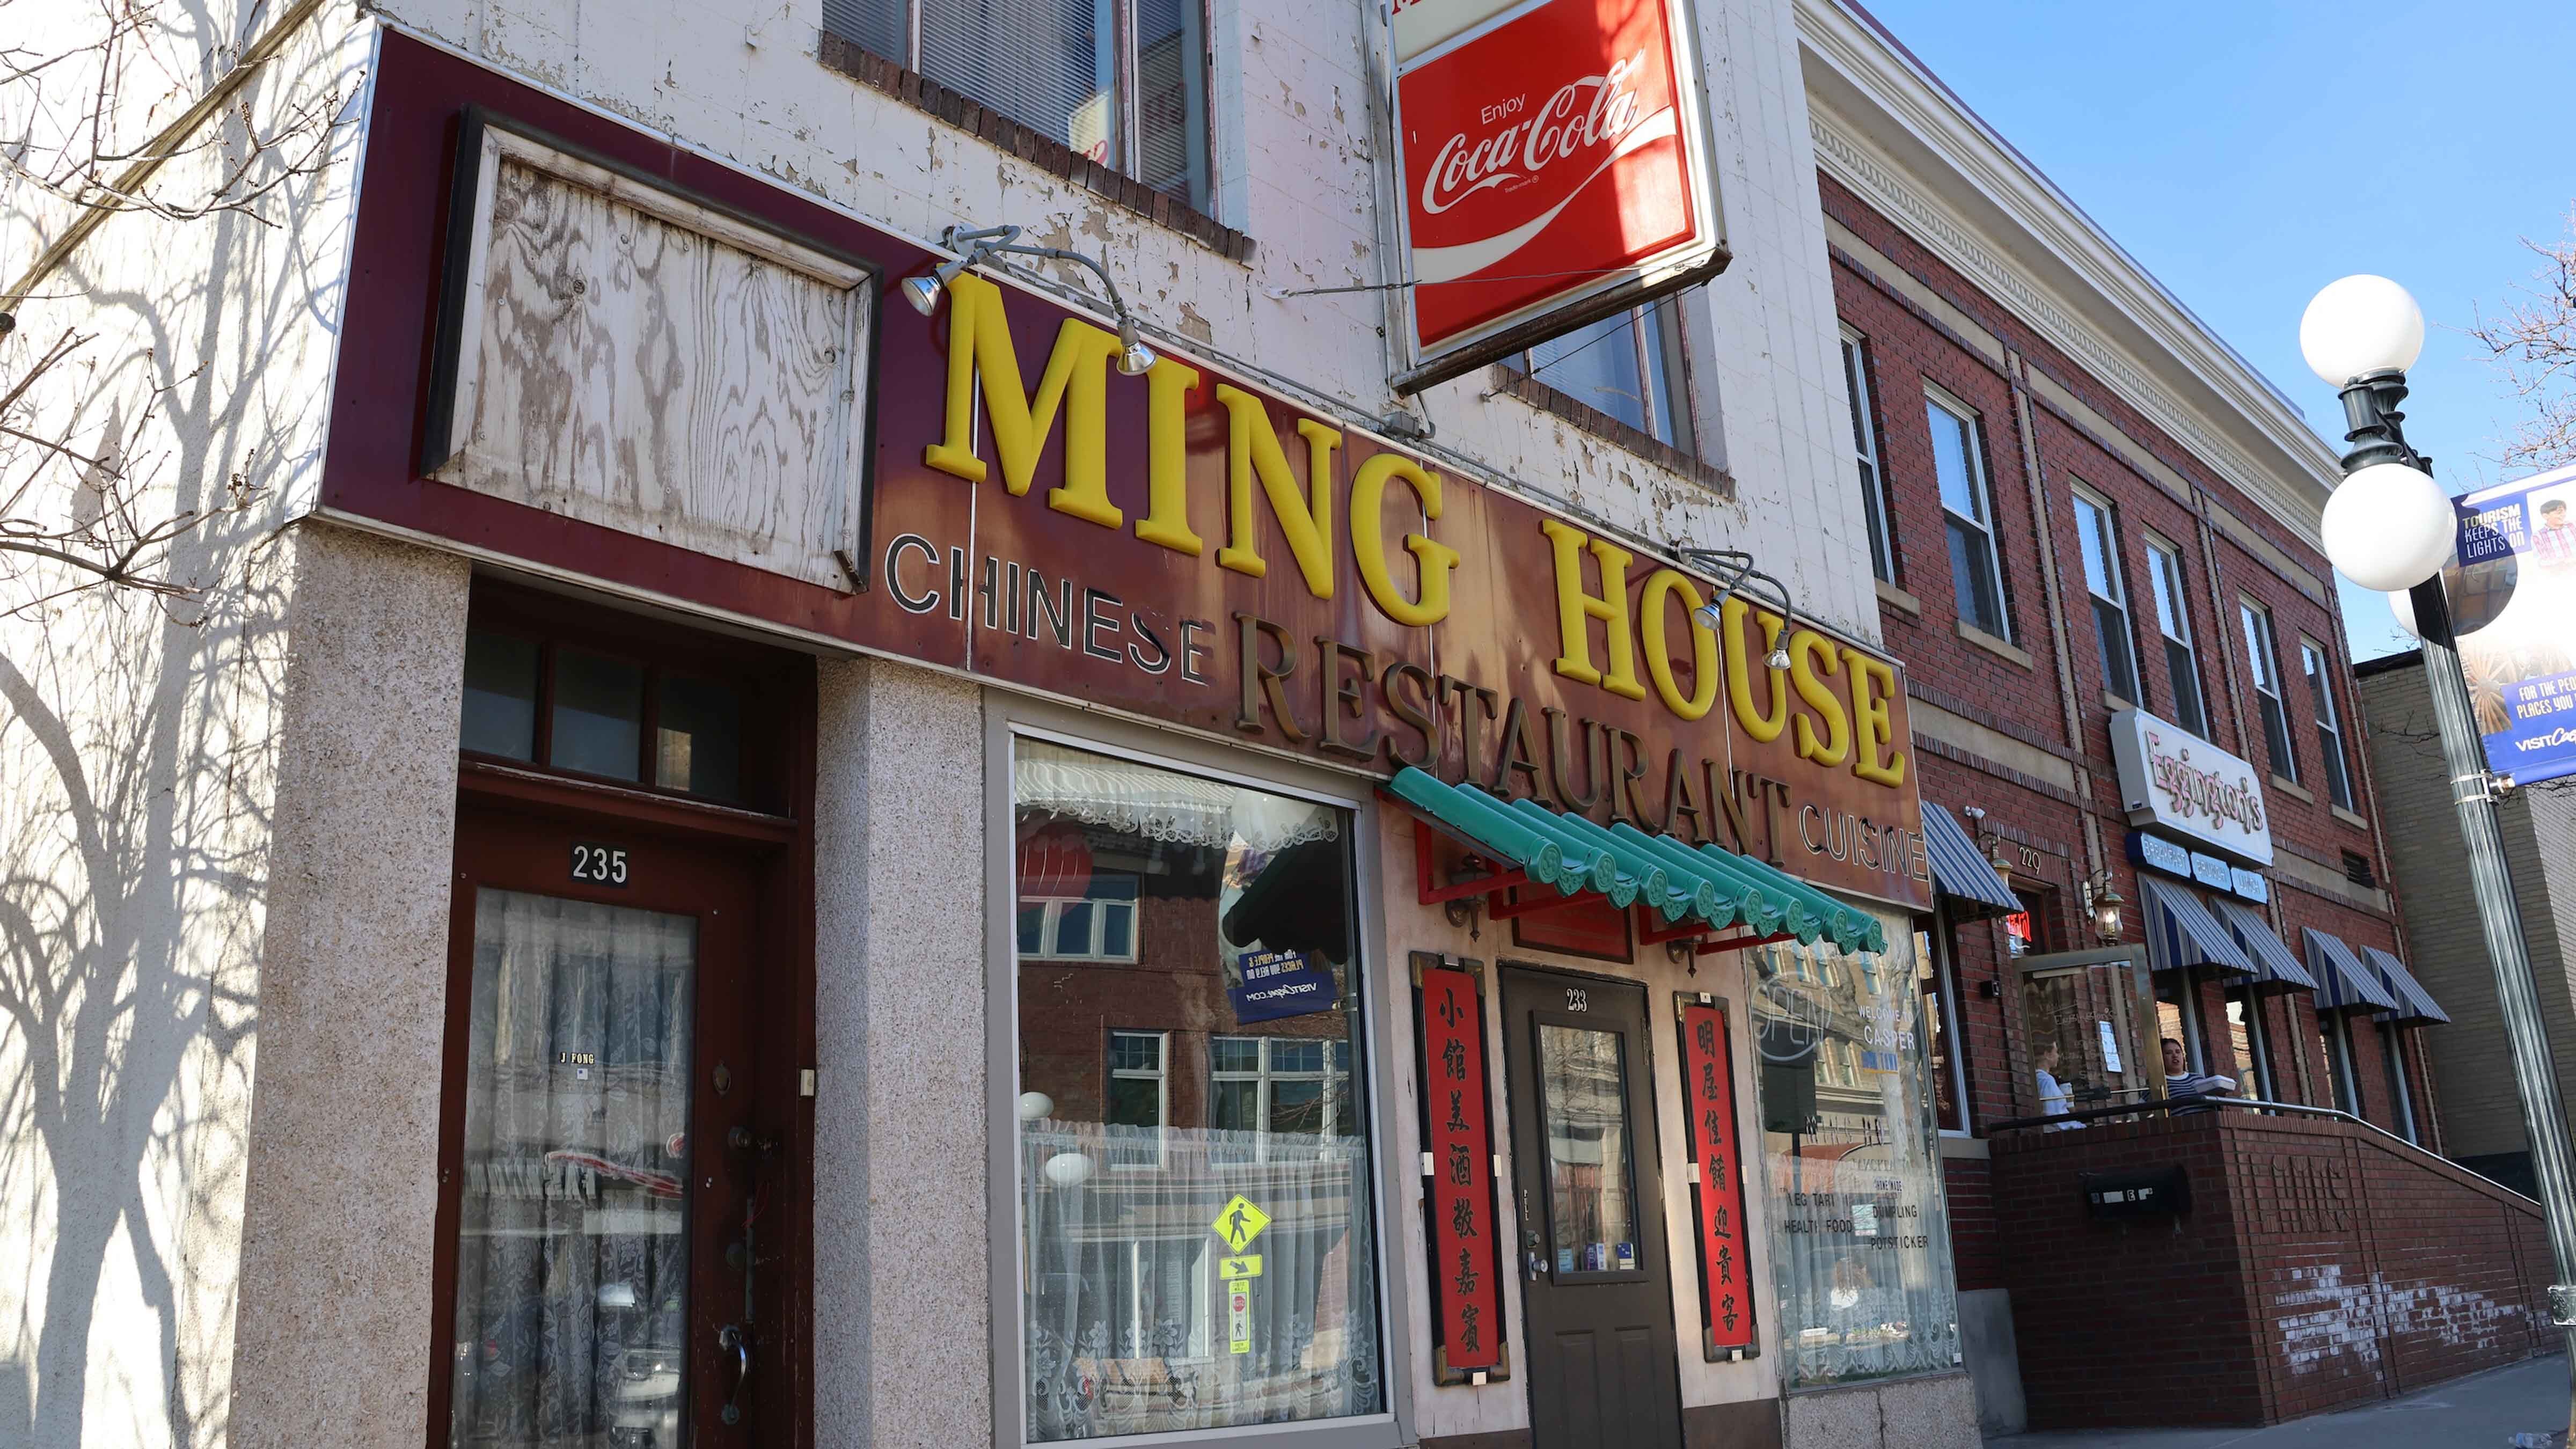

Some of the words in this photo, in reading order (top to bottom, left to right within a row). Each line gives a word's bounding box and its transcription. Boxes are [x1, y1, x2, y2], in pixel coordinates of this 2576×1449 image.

[1481, 93, 1526, 125] Enjoy
[926, 263, 1459, 626] MING
[1542, 519, 1905, 788] HOUSE
[2463, 503, 2520, 528] TOURISM
[2464, 523, 2499, 543] KEEPS
[2502, 516, 2522, 533] THE
[2467, 536, 2506, 558] LIGHTS
[2508, 531, 2525, 548] ON
[2519, 685, 2538, 701] FOR
[2538, 680, 2557, 697] THE
[884, 533, 1214, 686] CHINESE
[1232, 611, 1791, 867] RESTAURANT
[1798, 804, 1929, 882] CUISINE
[2516, 699, 2552, 719] PLACES
[2553, 694, 2573, 712] YOU
[2146, 730, 2263, 833] Eggington's
[573, 845, 627, 883] 235
[2019, 847, 2040, 875] 229
[1566, 988, 1587, 1012] 233
[1858, 1005, 1900, 1021] WELCOME
[1864, 1025, 1915, 1051] CASPER
[561, 1052, 566, 1063] J
[572, 1053, 594, 1064] FONG
[1826, 1219, 1853, 1233] FOOD
[1871, 1235, 1929, 1250] POTSTICKER
